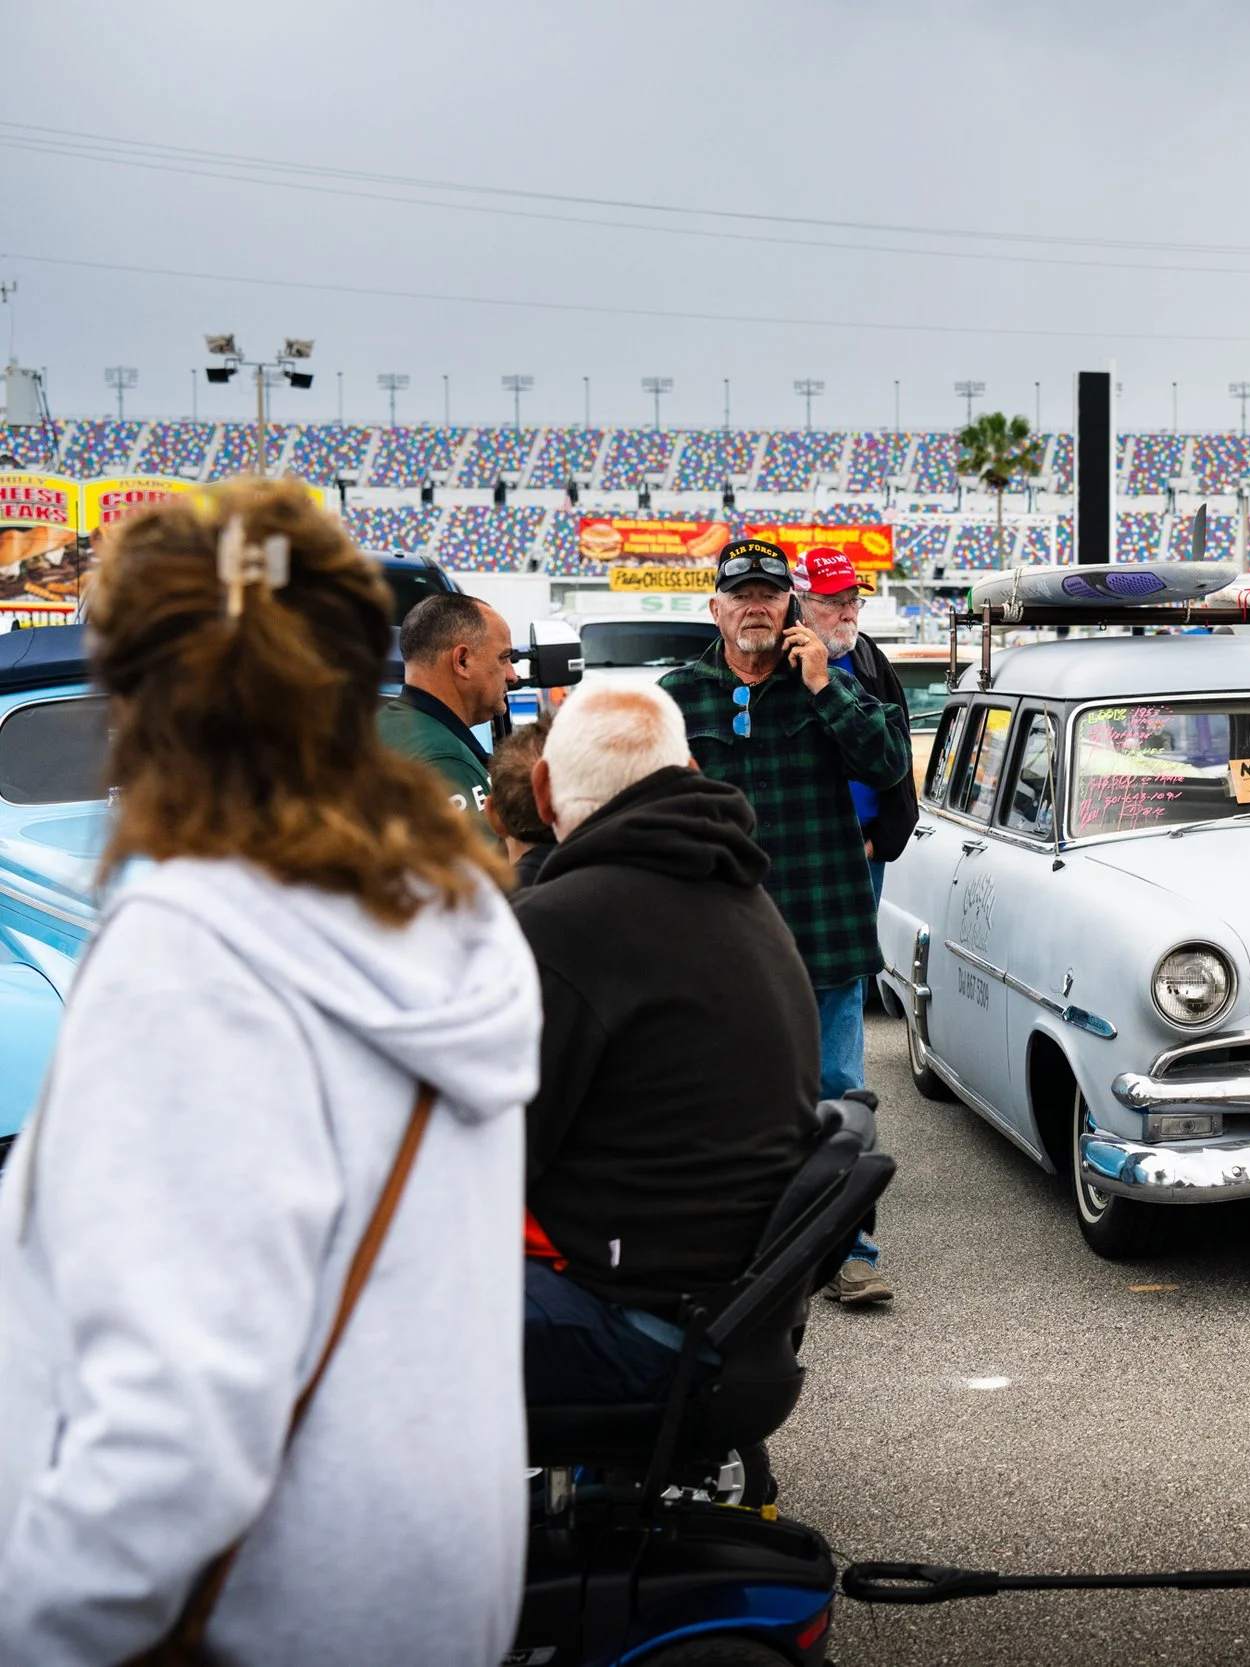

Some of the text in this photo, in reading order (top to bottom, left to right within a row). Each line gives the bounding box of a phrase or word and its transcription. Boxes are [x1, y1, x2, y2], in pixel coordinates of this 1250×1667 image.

[0, 487, 68, 505] HEESE
[101, 489, 186, 506] COR
[729, 545, 747, 559] AIR
[748, 543, 779, 559] FORCE
[813, 554, 848, 568] TRUMP
[643, 571, 681, 588] CHEESE
[1087, 708, 1128, 724] LOOK
